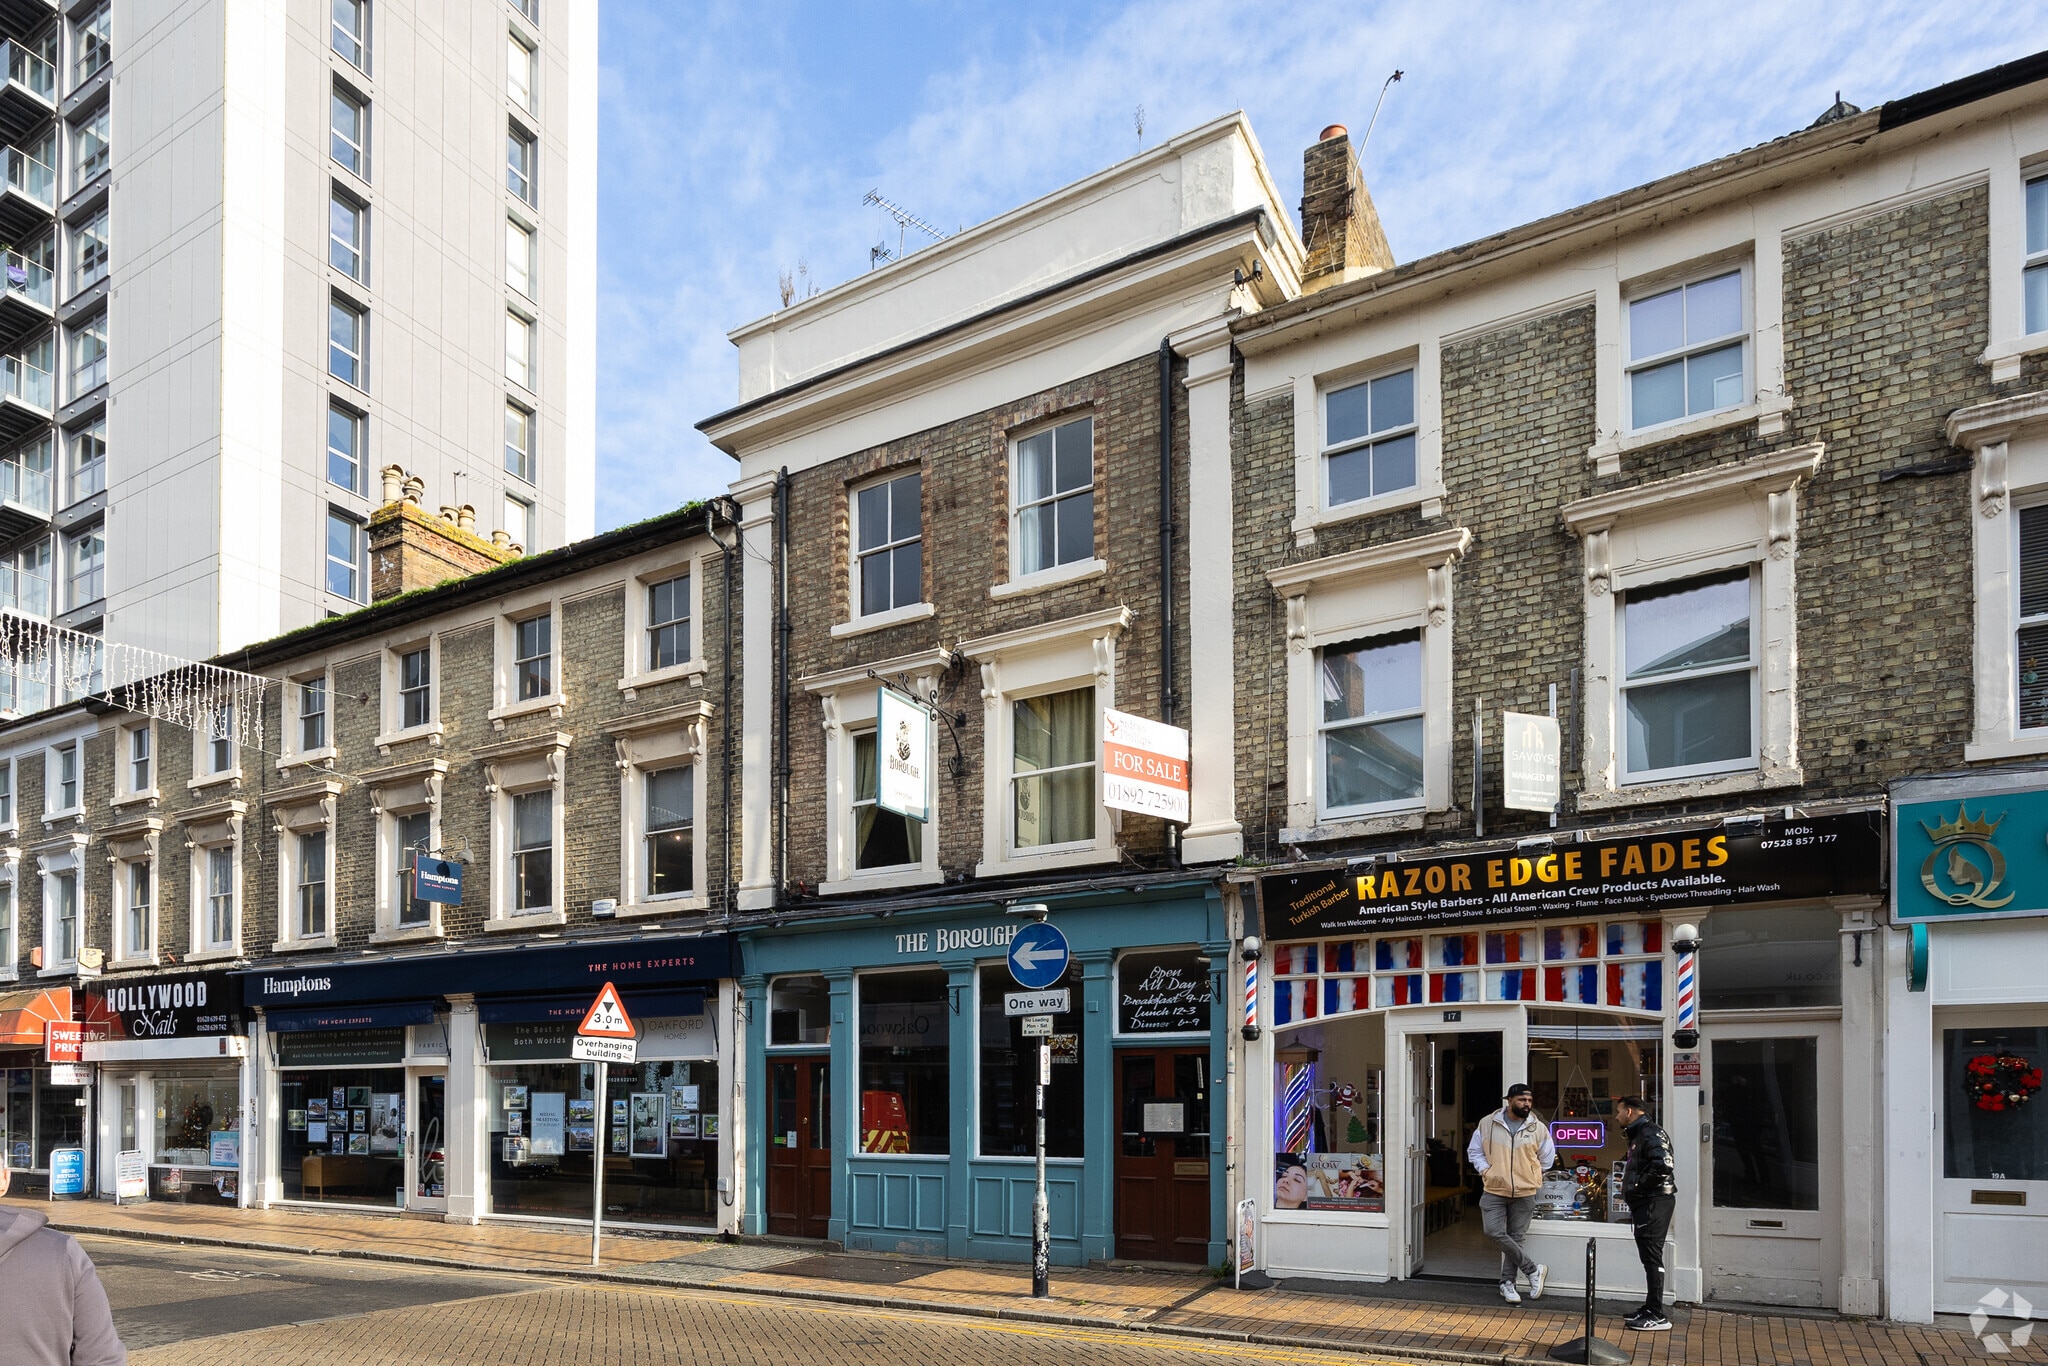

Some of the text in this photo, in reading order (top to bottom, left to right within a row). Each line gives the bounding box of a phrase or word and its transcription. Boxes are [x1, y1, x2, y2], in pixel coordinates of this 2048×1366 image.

[1512, 750, 1555, 765] SAVOYS
[889, 754, 919, 779] BOROUGH
[1113, 750, 1181, 783] FOR SALE
[1511, 771, 1556, 783] MANAGED BY
[1108, 781, 1144, 805] 01892
[1785, 826, 1813, 836] MOb:
[1761, 834, 1838, 849] 07528 857 177
[1357, 835, 1729, 901] RAZOR EDGE FADES
[420, 870, 459, 886] Hamptons
[1289, 879, 1337, 911] Traditional
[1359, 873, 1726, 915] American Style Barbers All American Crew Products Available.
[1288, 887, 1350, 927] Turkish Barber
[1321, 921, 1336, 929] Walk
[1348, 918, 1377, 927] Welcome
[1382, 917, 1395, 925] Any
[1395, 915, 1423, 923] Haircuts
[1441, 910, 1461, 919] Towel
[1462, 909, 1483, 917] Shave
[1493, 906, 1513, 915] Facial
[1514, 904, 1537, 913] Steam
[1542, 902, 1570, 911] Waxing
[1575, 899, 1599, 908] Flame
[1605, 897, 1622, 905] Face
[1623, 894, 1644, 903] Mask
[1650, 892, 1688, 902] Eyebrows
[1689, 887, 1732, 898] Threading
[1738, 885, 1755, 894] Hair
[1756, 883, 1781, 892] Wash
[895, 925, 1018, 954] THE BOROUGH
[588, 957, 695, 972] THE HOME EXPERTS
[1149, 965, 1183, 981] Open
[263, 975, 332, 997] Hamptons
[1138, 977, 1197, 997] All Day
[107, 981, 207, 1013] HOLLYWOOD
[1009, 997, 1064, 1010] One way
[1122, 993, 1181, 1010] Breakfast
[594, 1012, 623, 1025] 3.0 m
[1134, 1005, 1197, 1018] Lunch 12-3
[1448, 1012, 1457, 1020] 17
[133, 1009, 178, 1037] Nails
[515, 1025, 566, 1034] The Best of
[648, 1019, 704, 1032] OAKFORD
[1130, 1016, 1171, 1029] Dinner
[318, 1031, 337, 1039] living
[364, 1028, 402, 1037] difference
[514, 1036, 566, 1046] Both Worlds
[576, 1039, 633, 1051] Overhanging
[586, 1049, 622, 1060] building
[1556, 1128, 1598, 1140] OPEN
[1311, 1161, 1340, 1169] GLOW
